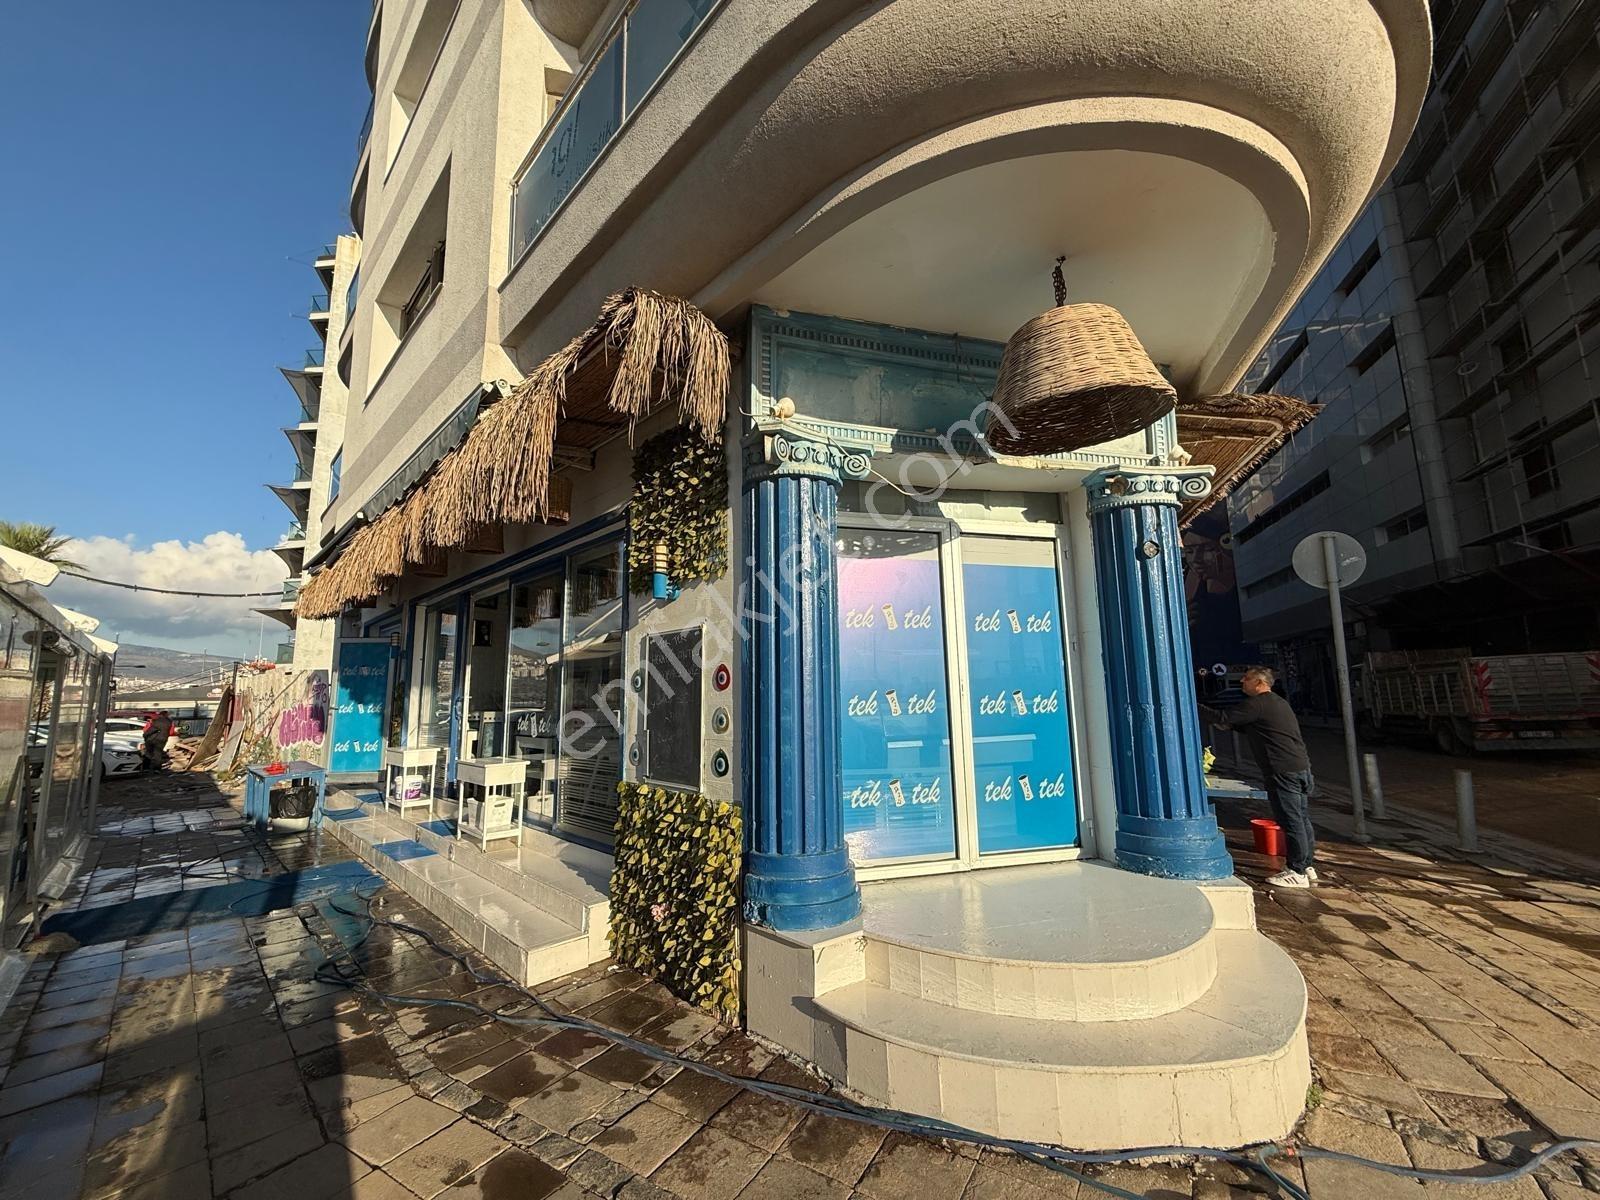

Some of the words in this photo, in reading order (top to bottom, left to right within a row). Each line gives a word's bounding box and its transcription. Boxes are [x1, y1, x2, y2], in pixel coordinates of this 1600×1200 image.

[845, 604, 874, 630] tek
[903, 605, 932, 630] tek
[974, 609, 1000, 633] tek
[1026, 610, 1052, 633] tek
[848, 690, 878, 715] tek
[907, 689, 936, 715] tek
[979, 690, 1006, 715] tek
[1032, 690, 1058, 713] tek
[850, 780, 881, 809] tek
[911, 778, 941, 804] tek
[984, 775, 1012, 801] tek
[1038, 773, 1065, 798] tek
